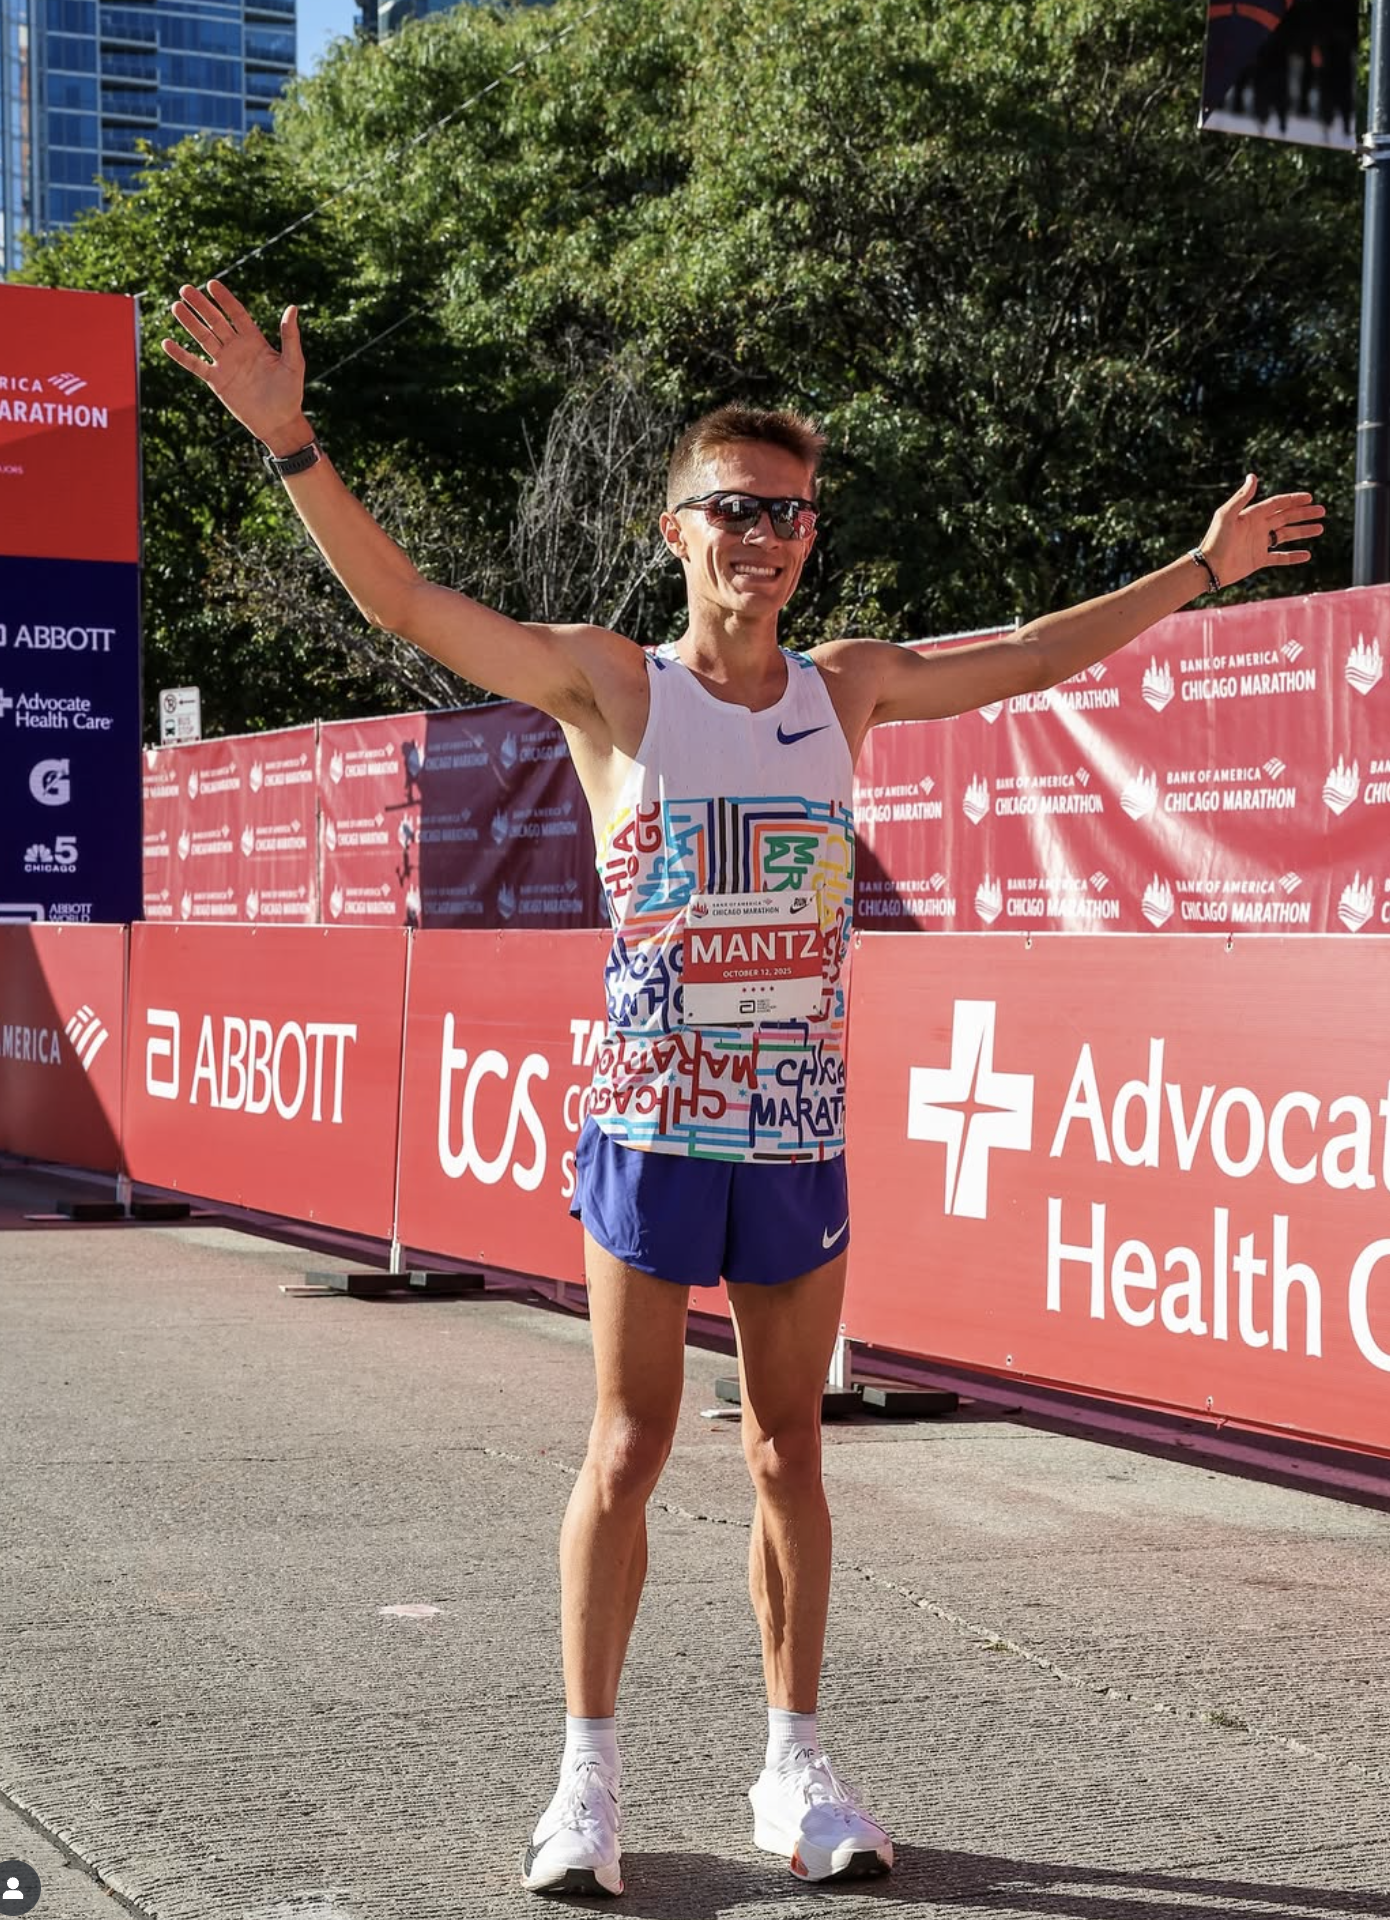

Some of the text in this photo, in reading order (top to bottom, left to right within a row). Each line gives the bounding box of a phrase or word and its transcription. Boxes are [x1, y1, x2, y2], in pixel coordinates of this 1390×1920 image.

[0, 399, 108, 428] ARATHON
[13, 624, 116, 652] ABBOTT
[1180, 650, 1279, 673] BANK OF AMERICA
[1181, 668, 1316, 702] CHICAGO MARATHON
[16, 692, 91, 711] Advocate
[1009, 691, 1050, 714] CHICAGO
[15, 710, 112, 730] Health Care
[1031, 774, 1075, 788] AMERICA
[1166, 767, 1261, 785] BANK OF AMERICA
[853, 787, 873, 800] ANK
[1164, 787, 1296, 813] CHICAGO MARATHON
[854, 800, 942, 823] HICAGO MARATHON
[995, 794, 1104, 817] CHICAGO MARATHON
[54, 836, 79, 865] 5
[24, 864, 77, 873] CHICAGO
[1205, 880, 1221, 893] OF
[1222, 880, 1275, 893] AMERICA
[49, 903, 93, 914] ABBOTT
[712, 906, 780, 916] CHICAGO MARATHON
[858, 898, 956, 917] CHICAGO MARATHON
[1007, 898, 1120, 919] CHICAGO MARATHON
[1181, 900, 1311, 923] CHICAGO MARATHON
[691, 930, 819, 964] MANTZ
[722, 970, 758, 978] OCTOBER
[774, 967, 792, 976] 2025
[1, 1024, 62, 1065] MERICA
[570, 1019, 606, 1067] TA
[189, 1015, 357, 1123] ABBOTT
[438, 1012, 550, 1191] tcs
[749, 1093, 845, 1149] MARAT
[1046, 1196, 1322, 1358] Health
